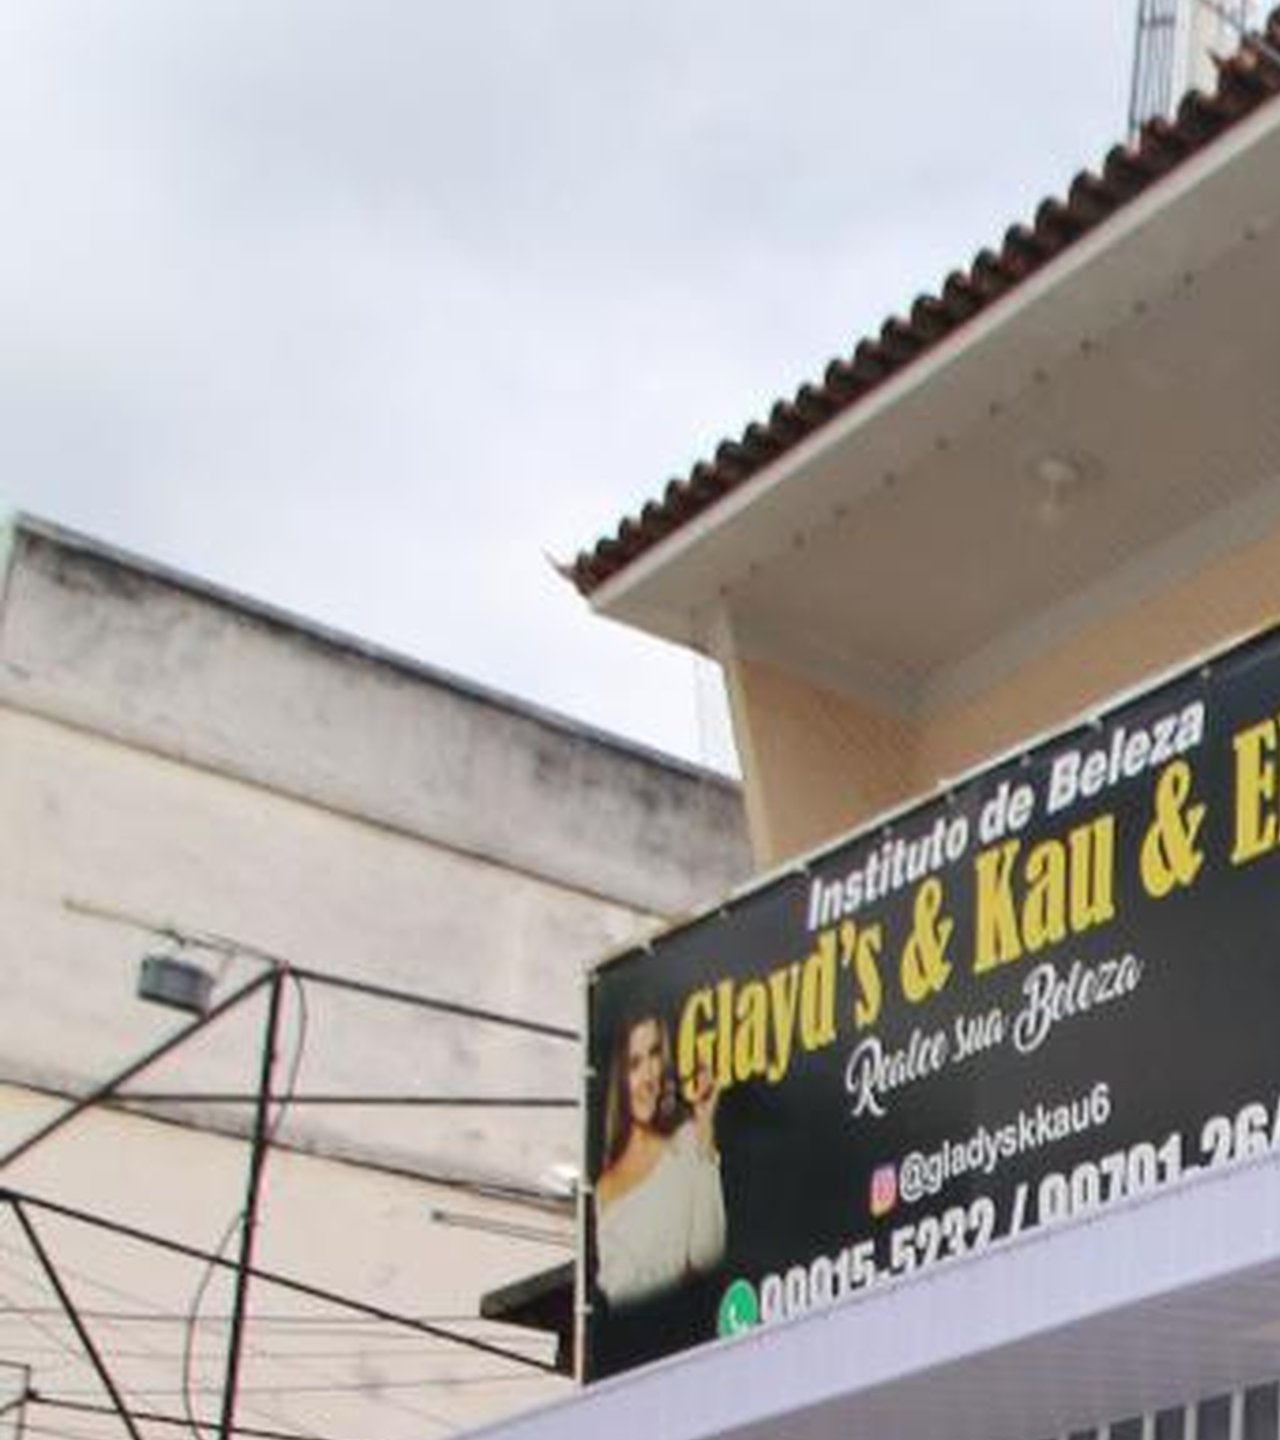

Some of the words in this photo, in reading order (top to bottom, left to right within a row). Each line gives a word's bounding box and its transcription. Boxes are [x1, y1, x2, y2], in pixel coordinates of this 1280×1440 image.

[807, 814, 969, 931] Instituto
[978, 781, 1036, 845] de
[1047, 700, 1205, 814] Beleza
[676, 918, 883, 1106] Glayd's
[899, 875, 954, 1004] &
[973, 813, 1116, 974] Kau
[1139, 759, 1207, 899] &
[845, 1026, 950, 1118] Realce
[1013, 953, 1145, 1053] Beleza
[899, 1081, 1111, 1202] @gladyskkau6
